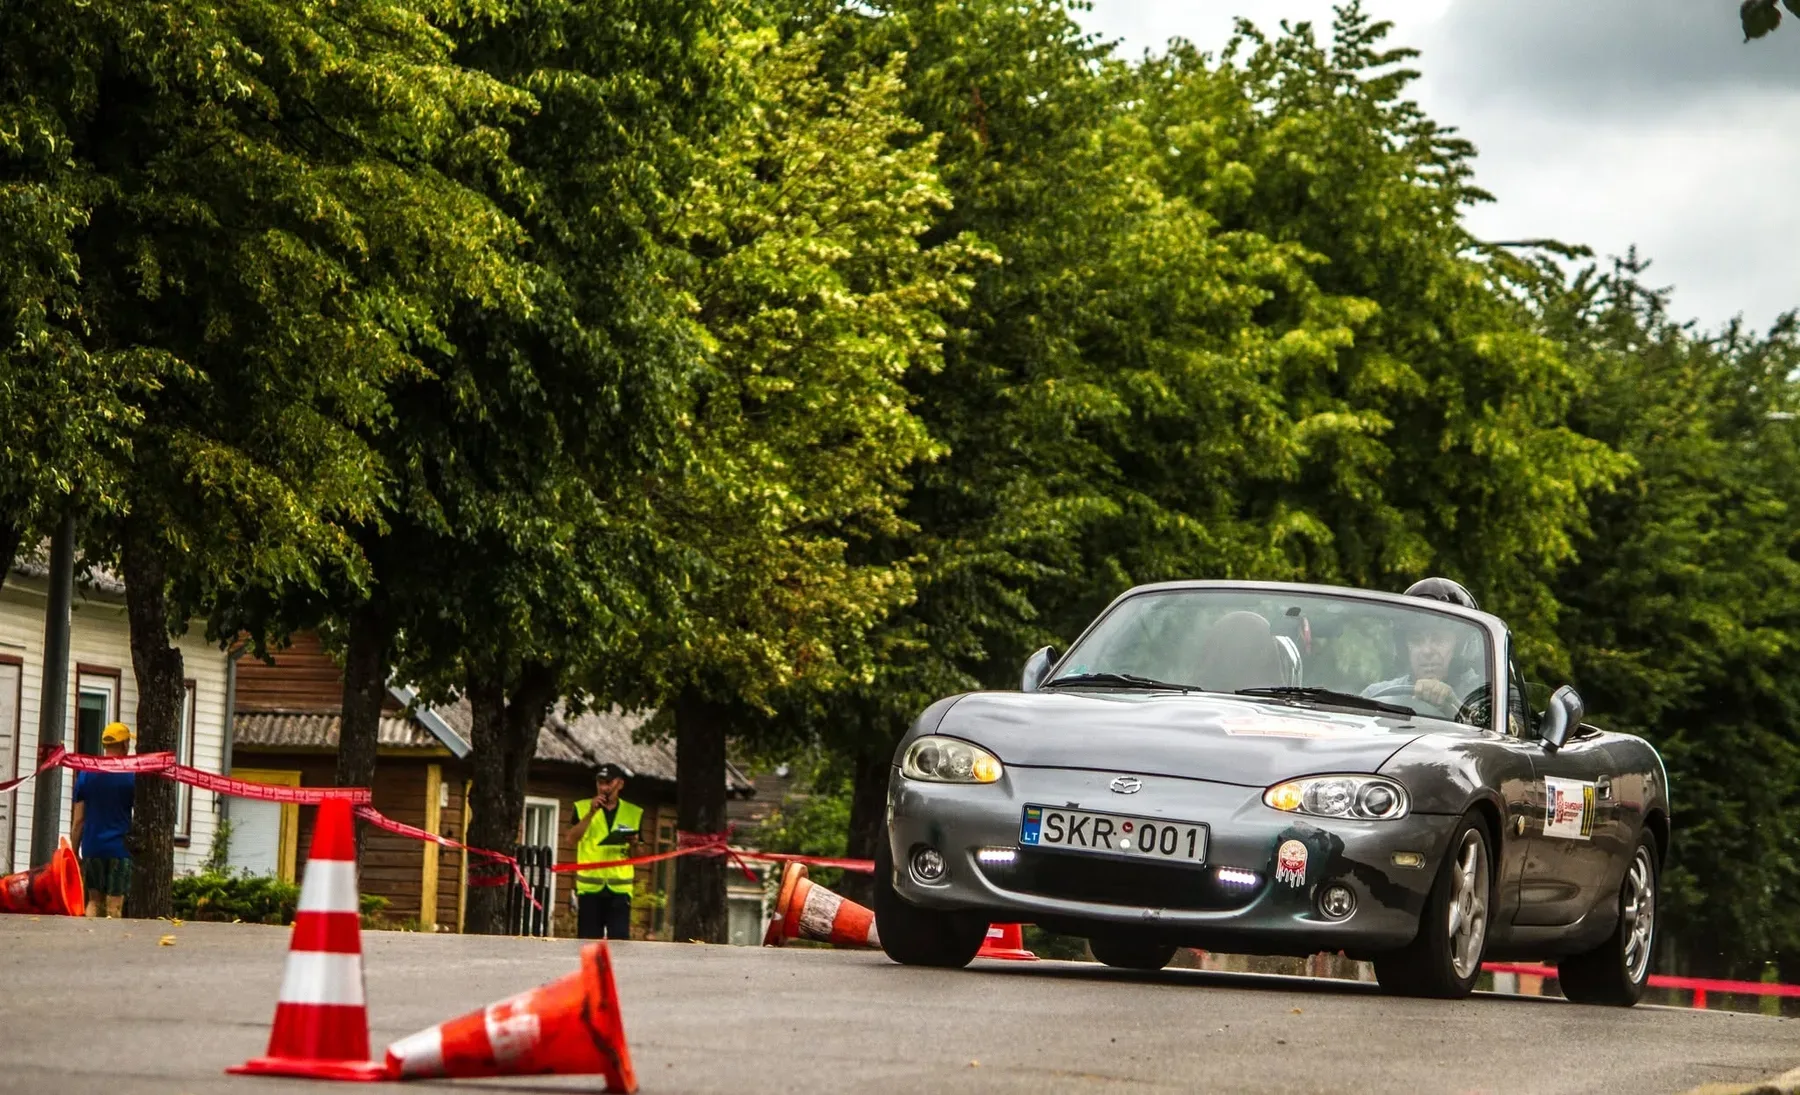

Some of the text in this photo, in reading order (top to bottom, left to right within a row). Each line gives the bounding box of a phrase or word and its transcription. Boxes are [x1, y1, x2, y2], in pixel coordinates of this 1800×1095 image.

[1024, 831, 1038, 841] LT
[1044, 813, 1197, 858] SKR 001
